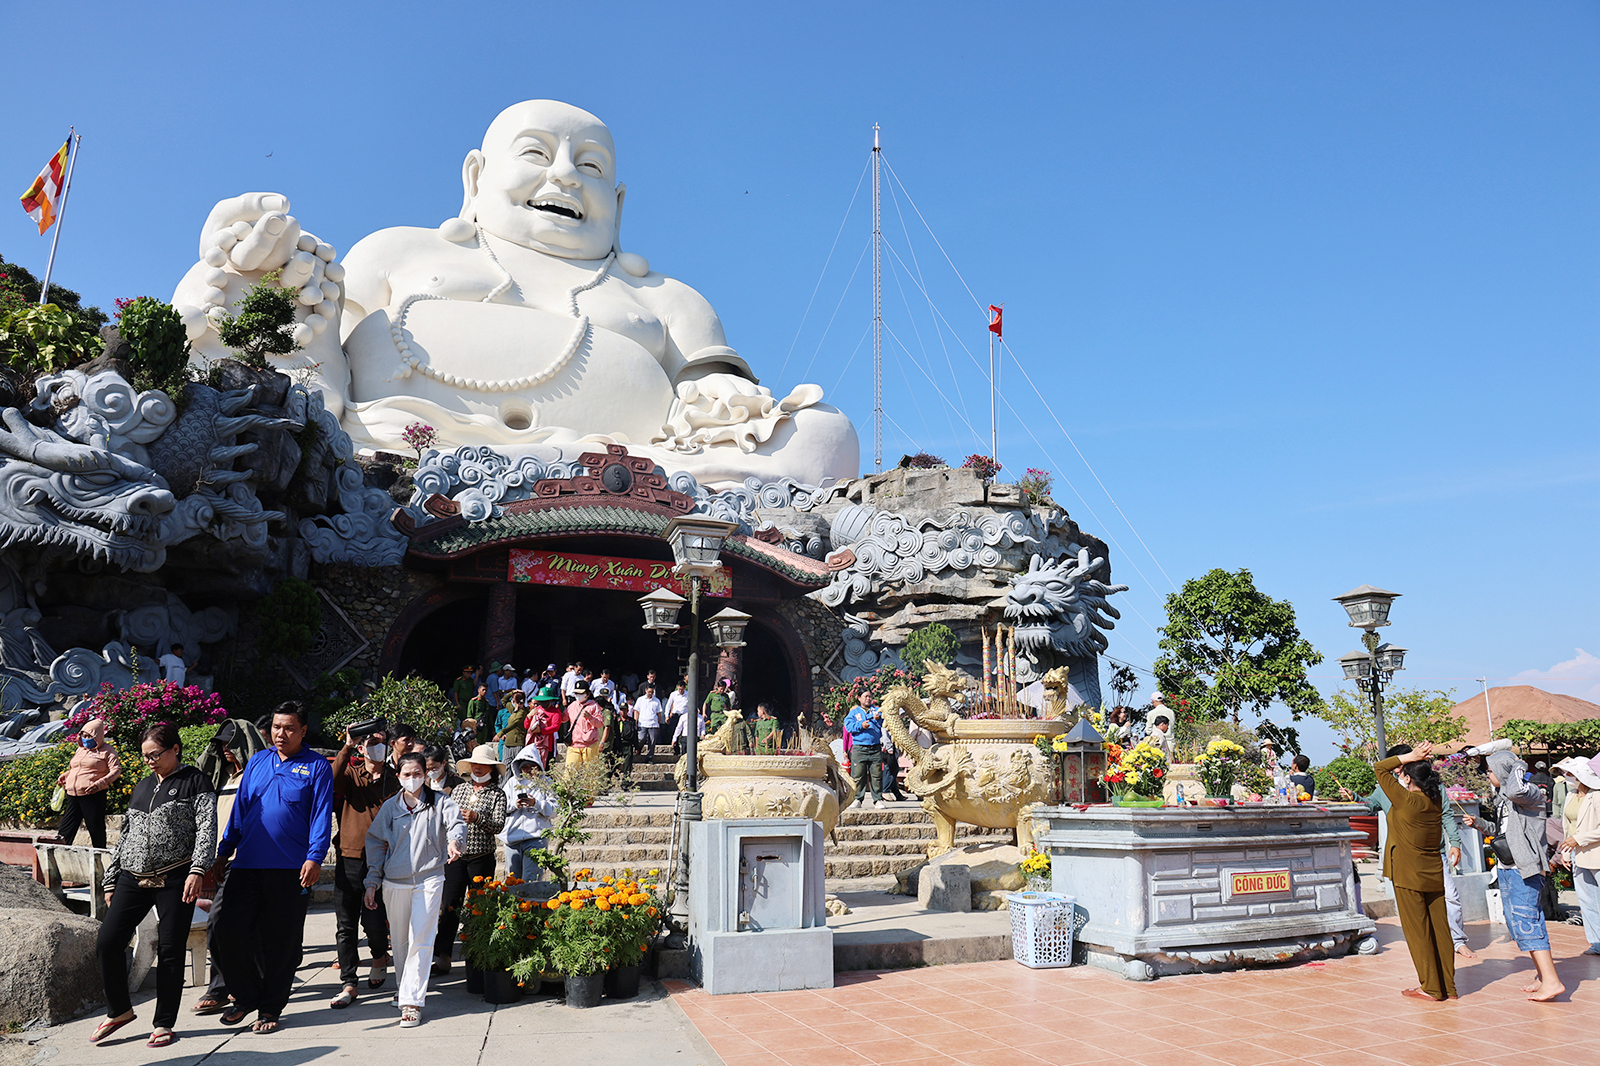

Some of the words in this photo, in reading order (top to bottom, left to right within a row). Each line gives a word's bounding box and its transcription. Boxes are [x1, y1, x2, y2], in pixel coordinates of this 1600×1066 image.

[547, 554, 600, 580] Mừng
[602, 561, 645, 578] Xuân
[650, 563, 671, 580] Di
[1235, 875, 1264, 892] CÔNG
[1266, 873, 1287, 890] ĐỨC
